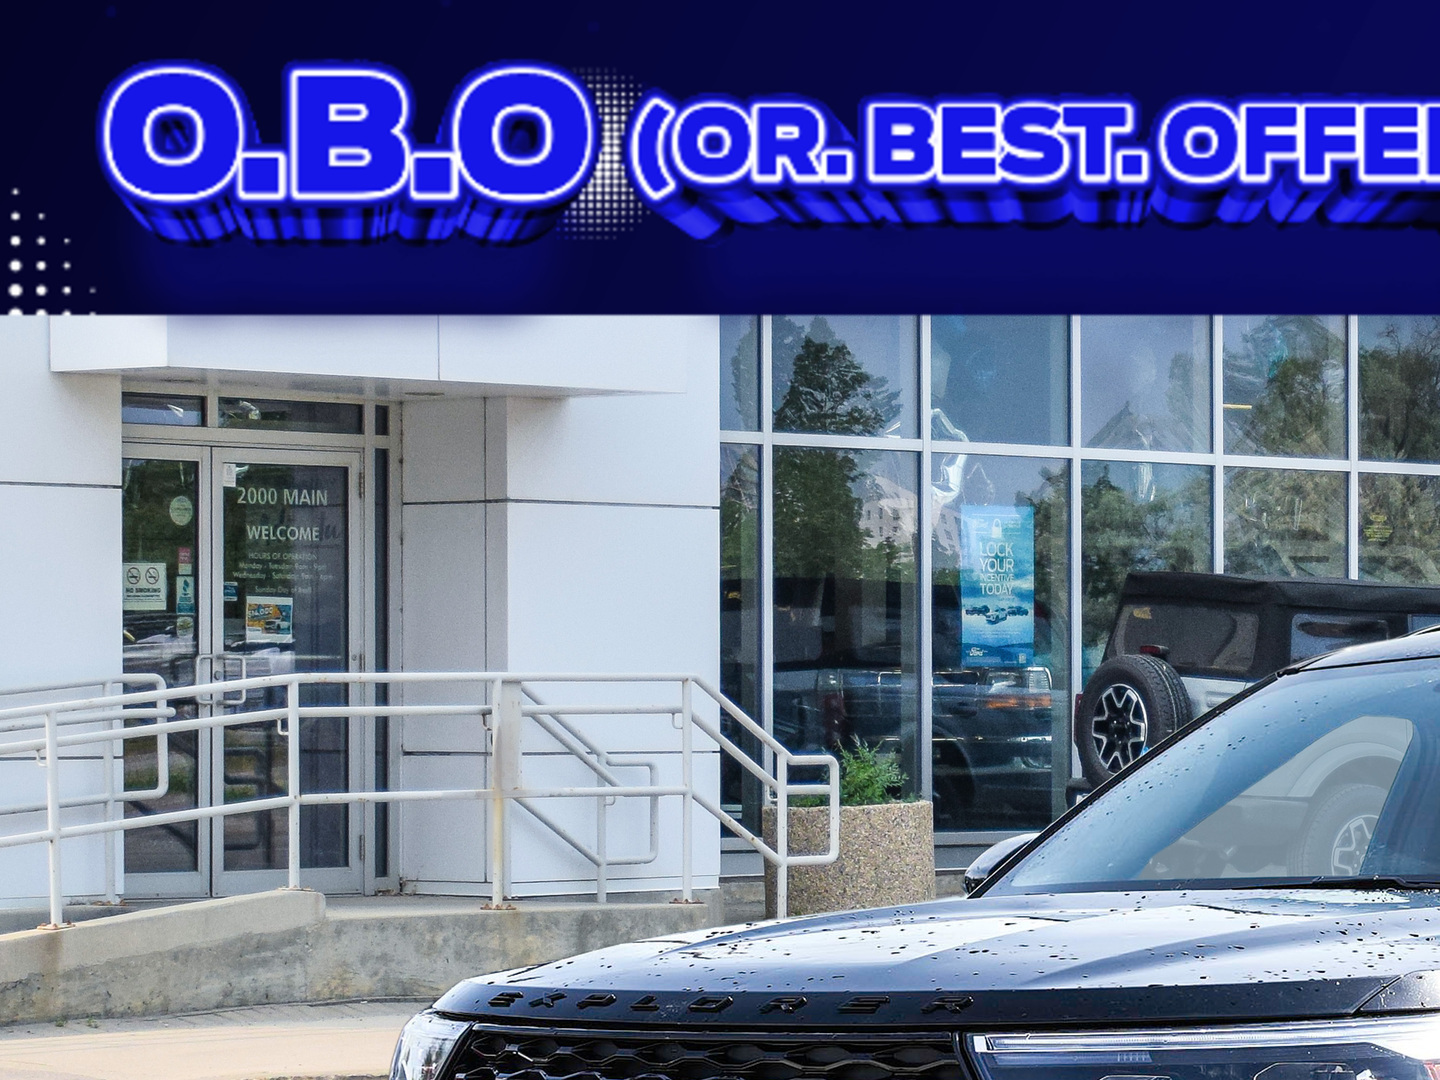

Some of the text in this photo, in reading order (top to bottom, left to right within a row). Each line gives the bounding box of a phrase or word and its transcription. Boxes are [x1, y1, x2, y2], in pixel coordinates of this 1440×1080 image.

[237, 487, 328, 506] 2000 MAIN
[246, 525, 320, 541] WELCOME
[979, 542, 1014, 557] LOCK
[979, 558, 1014, 572] YOUR
[980, 583, 1014, 595] TODAY
[969, 647, 985, 657] Ford
[487, 990, 976, 1014] EXPLORER
